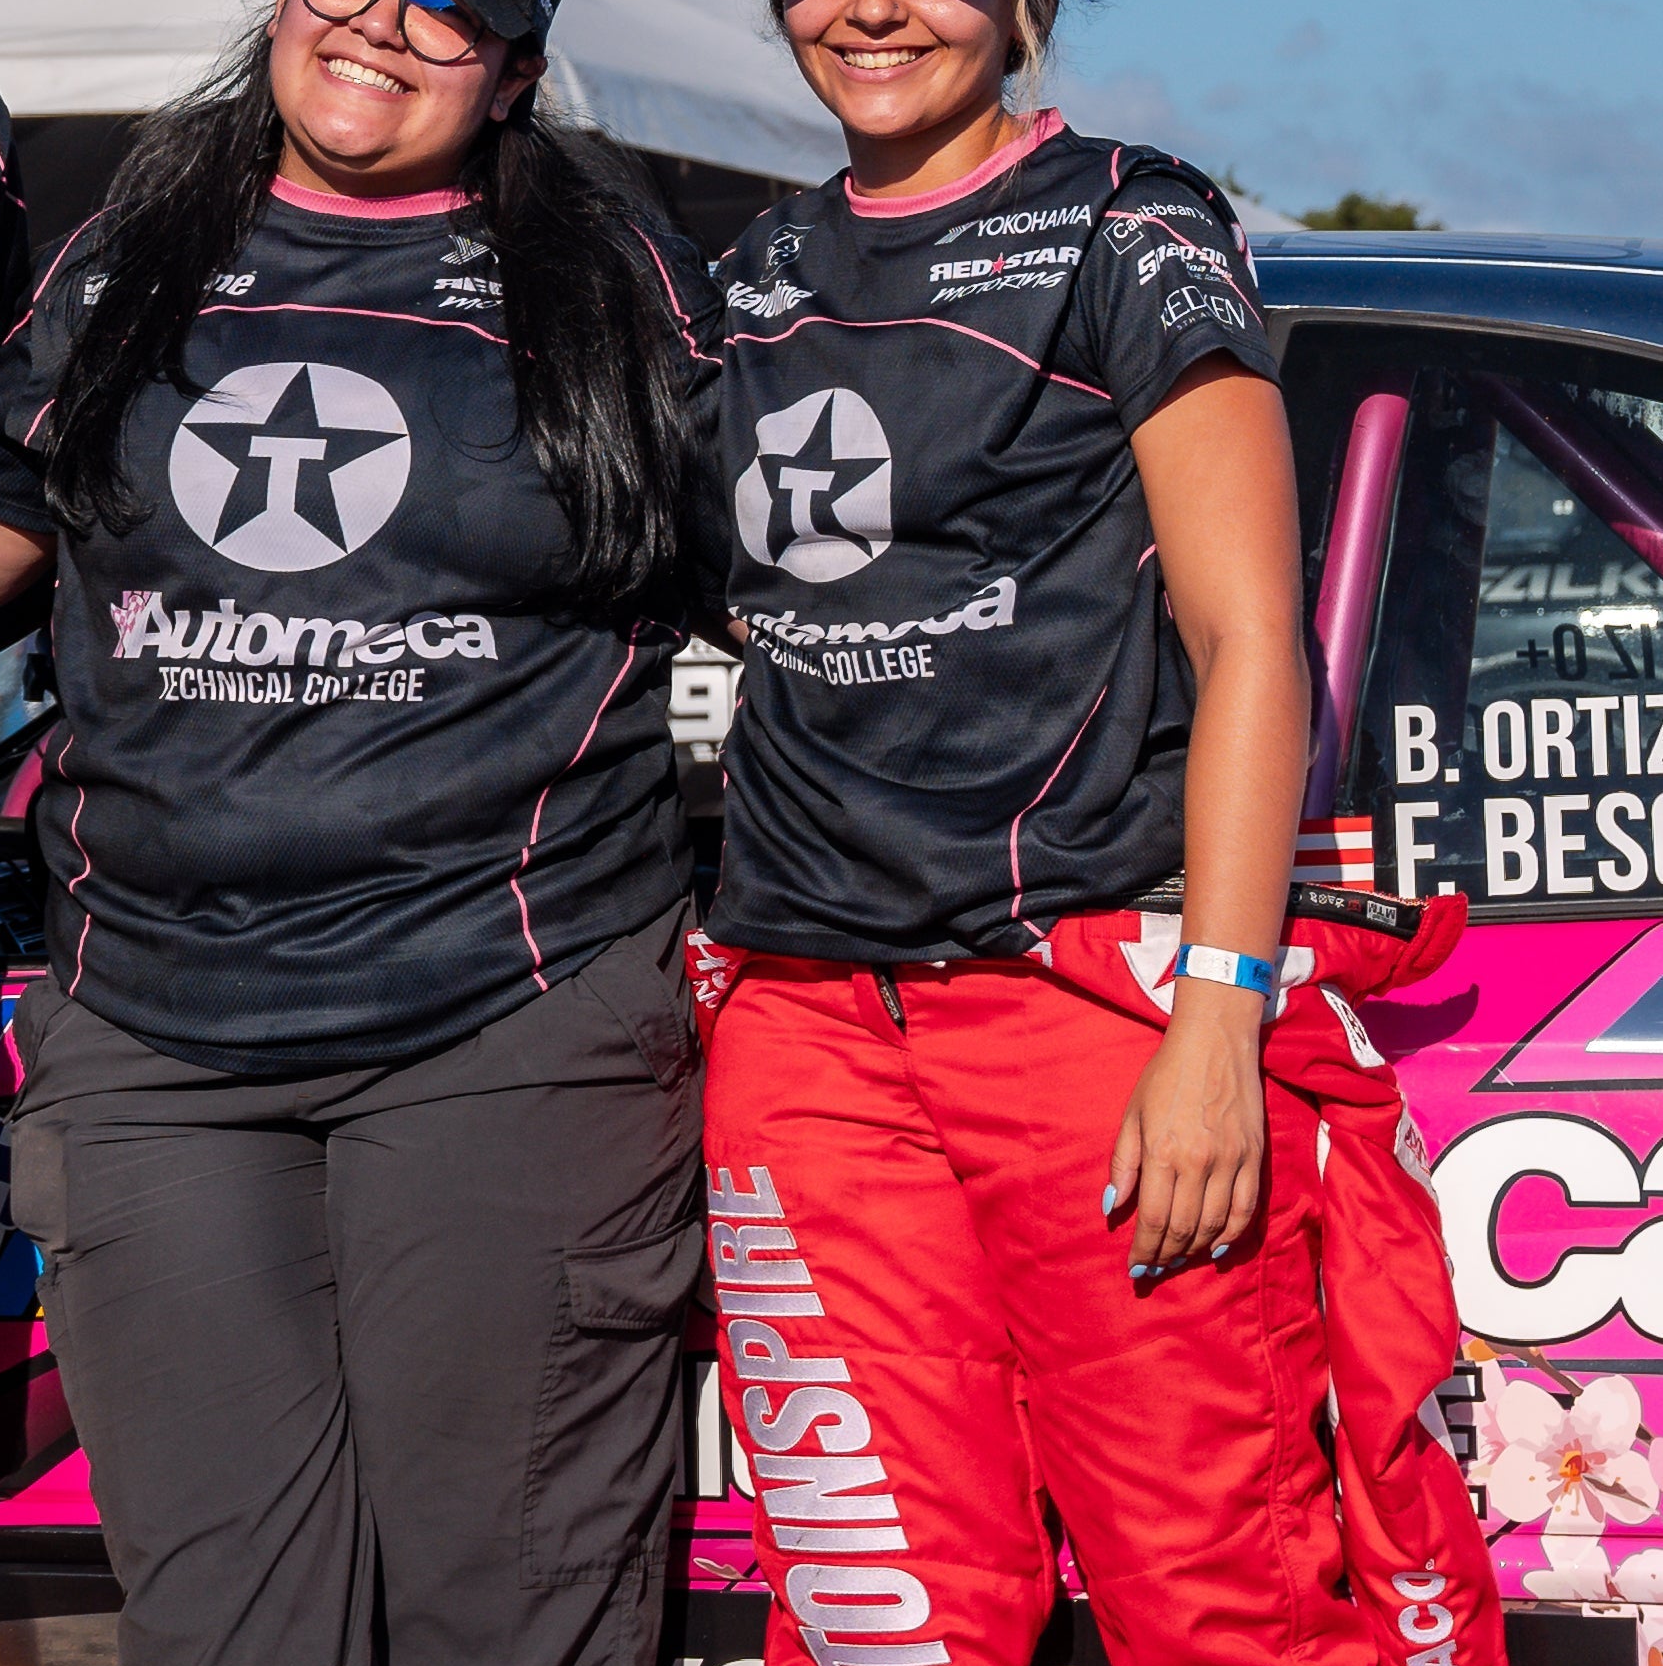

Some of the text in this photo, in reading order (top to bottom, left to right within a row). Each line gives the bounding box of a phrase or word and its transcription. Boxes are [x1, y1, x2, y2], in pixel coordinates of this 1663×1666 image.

[976, 204, 1093, 238] YOKOHAMA
[1112, 201, 1195, 240] Caribbean
[1002, 245, 1084, 270] STAR
[1137, 241, 1229, 286] Snap-on
[929, 270, 1068, 305] MOTORING
[1480, 563, 1663, 603] FALK
[122, 590, 499, 669] Automeca
[821, 643, 936, 686] COLLEGE
[158, 666, 426, 706] TECHNICAL COLLEGE
[1394, 704, 1461, 784] B.
[1394, 790, 1663, 900] F. BES
